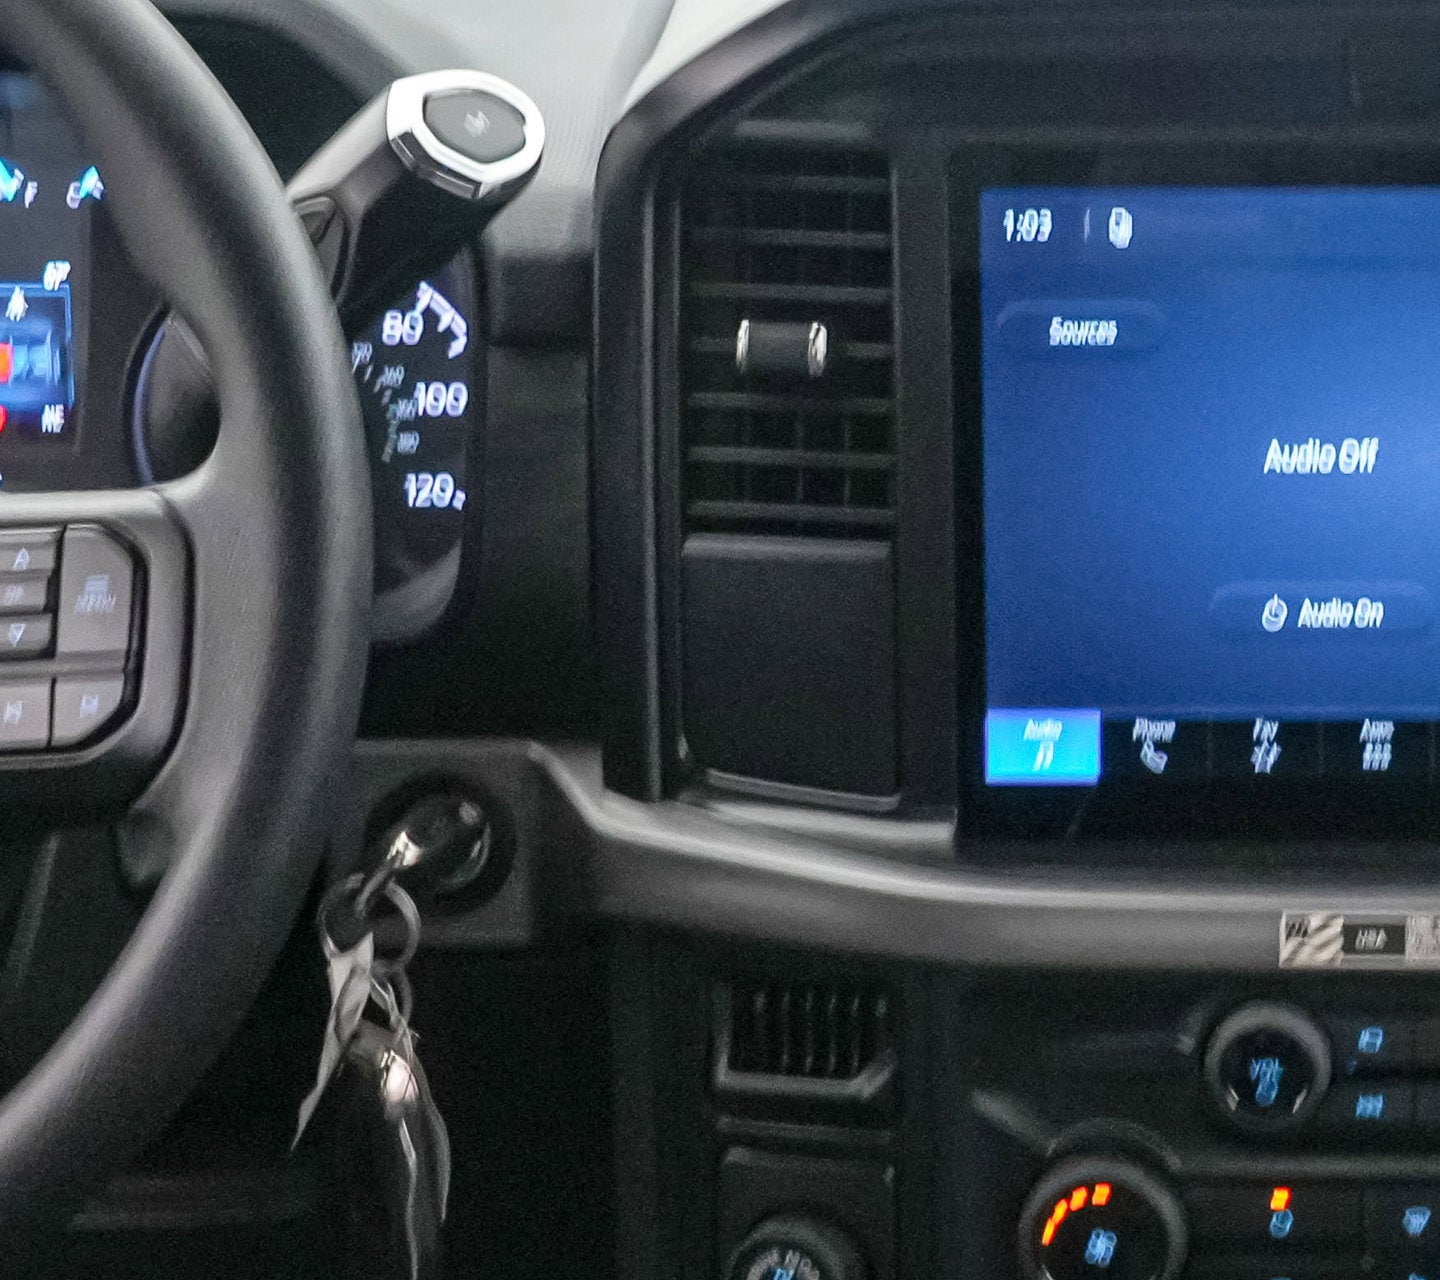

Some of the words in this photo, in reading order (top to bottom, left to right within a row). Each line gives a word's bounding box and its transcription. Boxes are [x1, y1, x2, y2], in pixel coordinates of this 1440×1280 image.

[382, 309, 424, 346] 80
[1049, 316, 1118, 346] Sources
[414, 381, 468, 417] 100
[1264, 438, 1336, 473] Audio
[1339, 437, 1379, 474] Off
[405, 472, 454, 508] 120
[1298, 597, 1354, 629] Audio
[1355, 597, 1384, 629] On
[1023, 718, 1063, 742] Audio
[1132, 717, 1176, 743] Phone
[1360, 718, 1395, 744] Apps
[1250, 1057, 1283, 1082] VOL
